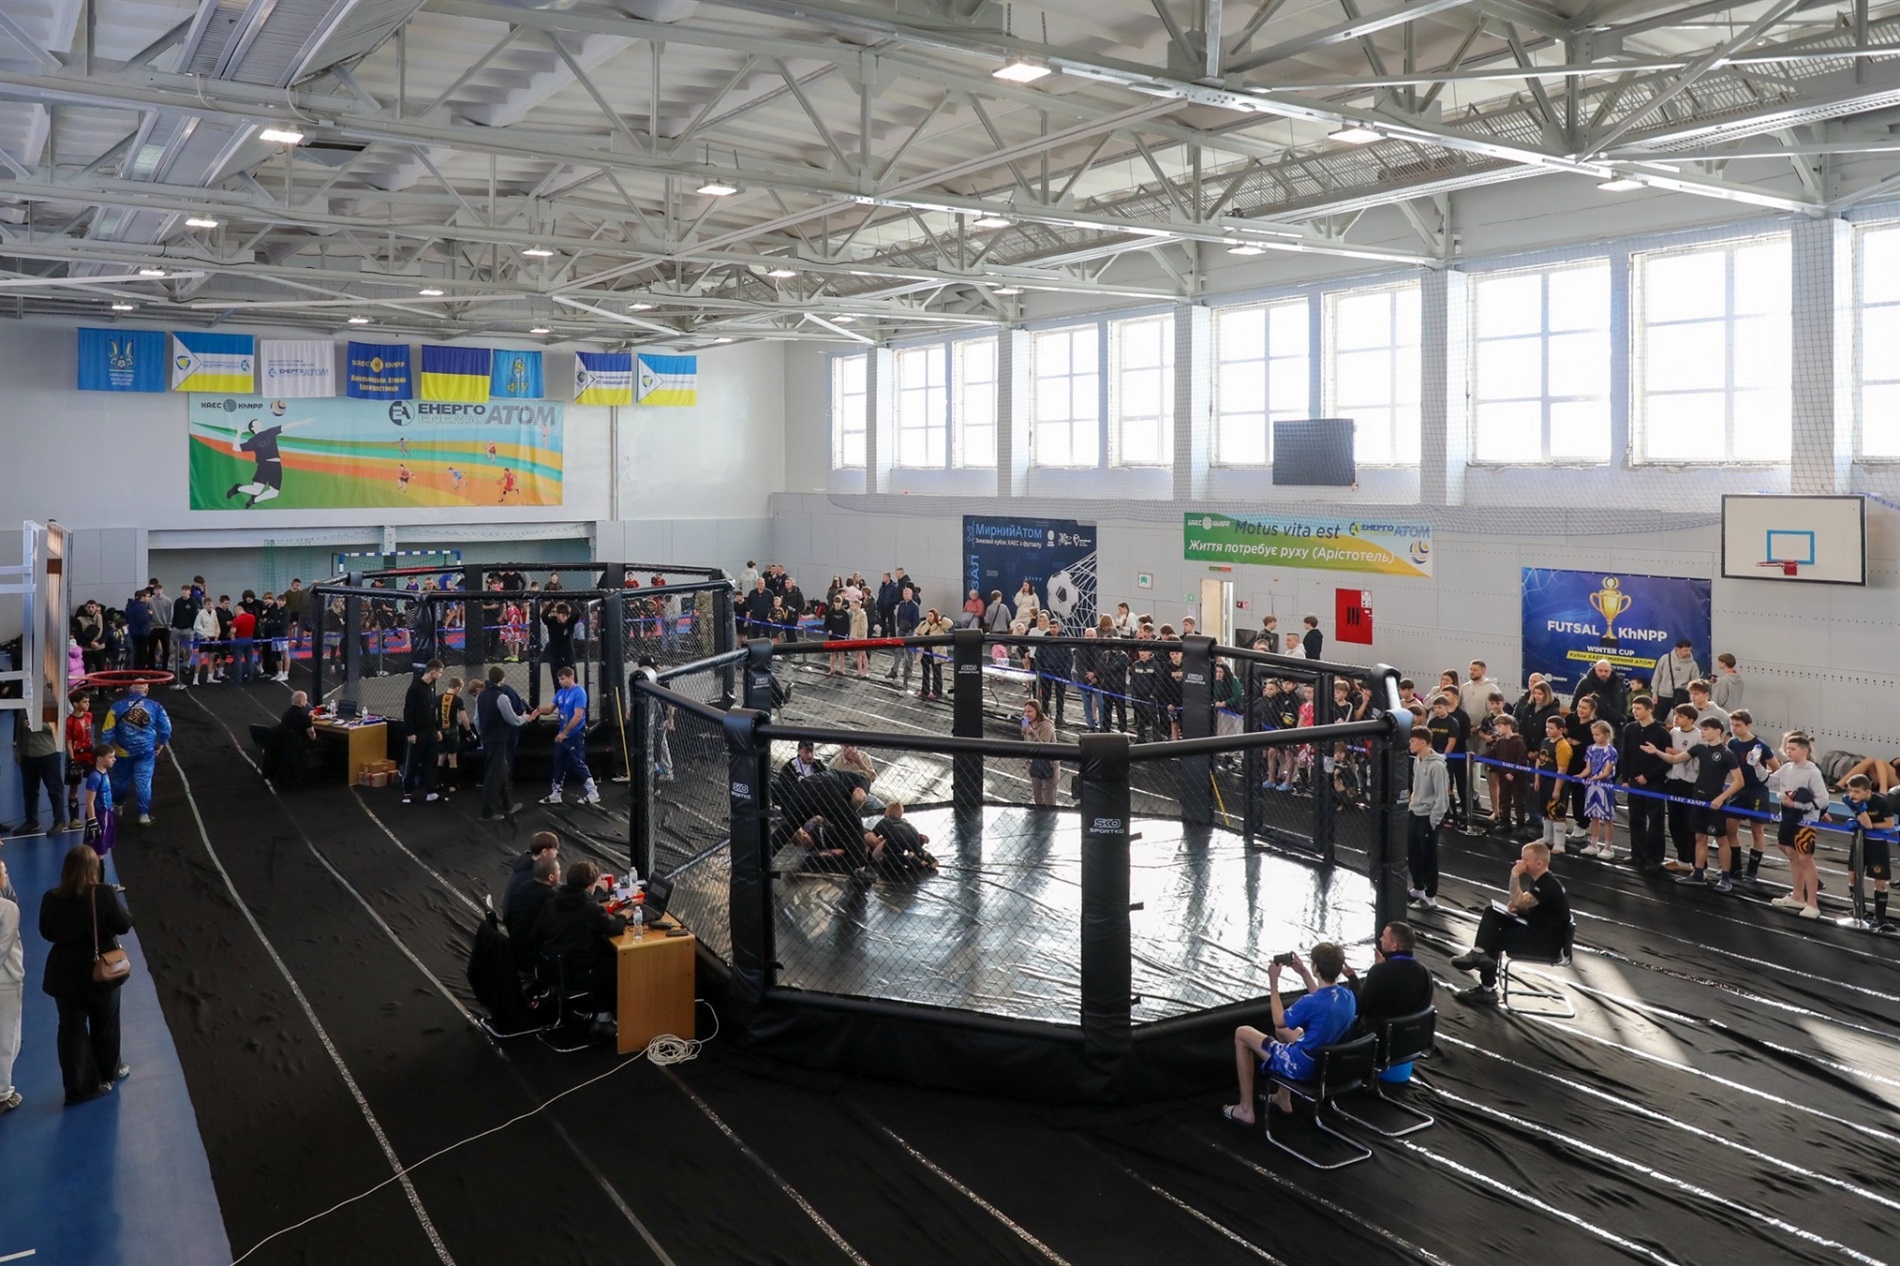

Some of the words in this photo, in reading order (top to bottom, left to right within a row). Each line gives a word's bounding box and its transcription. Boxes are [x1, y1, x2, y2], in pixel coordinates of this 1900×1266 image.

[418, 403, 486, 415] ЕНЕРГО
[1234, 520, 1278, 536] Motus
[1283, 522, 1311, 538] vita
[1316, 524, 1341, 539] est
[1188, 540, 1222, 552] Життя
[1224, 543, 1278, 556] потребує
[1280, 547, 1310, 560] руху
[1312, 547, 1395, 564] (Арістотель)
[1547, 620, 1600, 636] FUTSAL
[1618, 627, 1668, 642] KhNPP
[1586, 646, 1617, 655] WINTER
[1093, 817, 1122, 829] SKO
